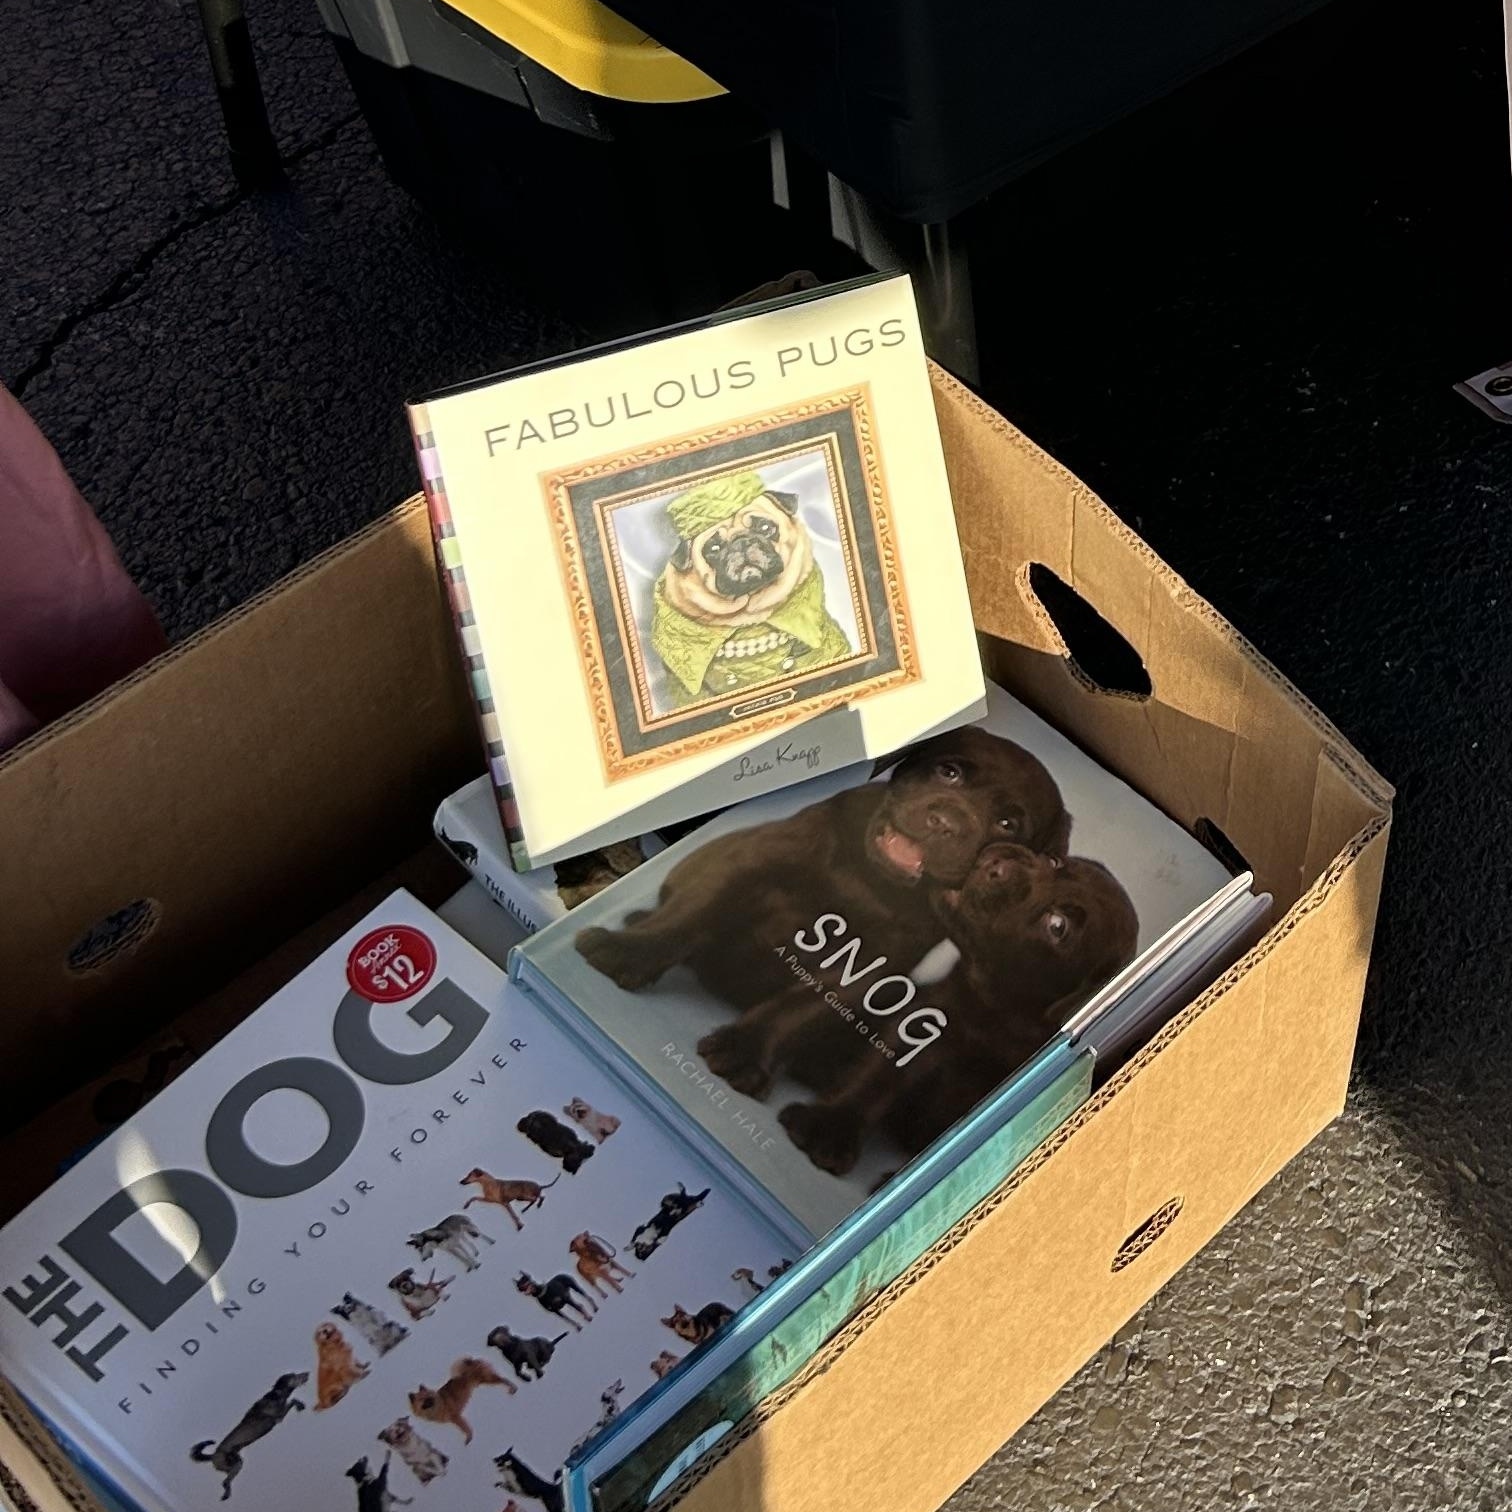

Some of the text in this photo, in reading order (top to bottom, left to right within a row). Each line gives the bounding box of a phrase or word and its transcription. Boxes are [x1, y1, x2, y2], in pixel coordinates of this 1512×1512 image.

[484, 318, 907, 459] FABULOUS PUGS
[733, 742, 822, 782] Lisa Knapp
[357, 933, 400, 968] BOOK
[485, 873, 538, 934] THE ILLUS
[371, 954, 425, 991] $12
[773, 944, 897, 1060] A Puppy's Guide to Love
[795, 913, 948, 1068] SNOG
[57, 976, 491, 1332] DOG
[660, 1041, 777, 1151] RACHAEL HALE
[118, 1035, 528, 1414] FINDING YOUR FOREVER
[6, 1255, 130, 1383] THE
